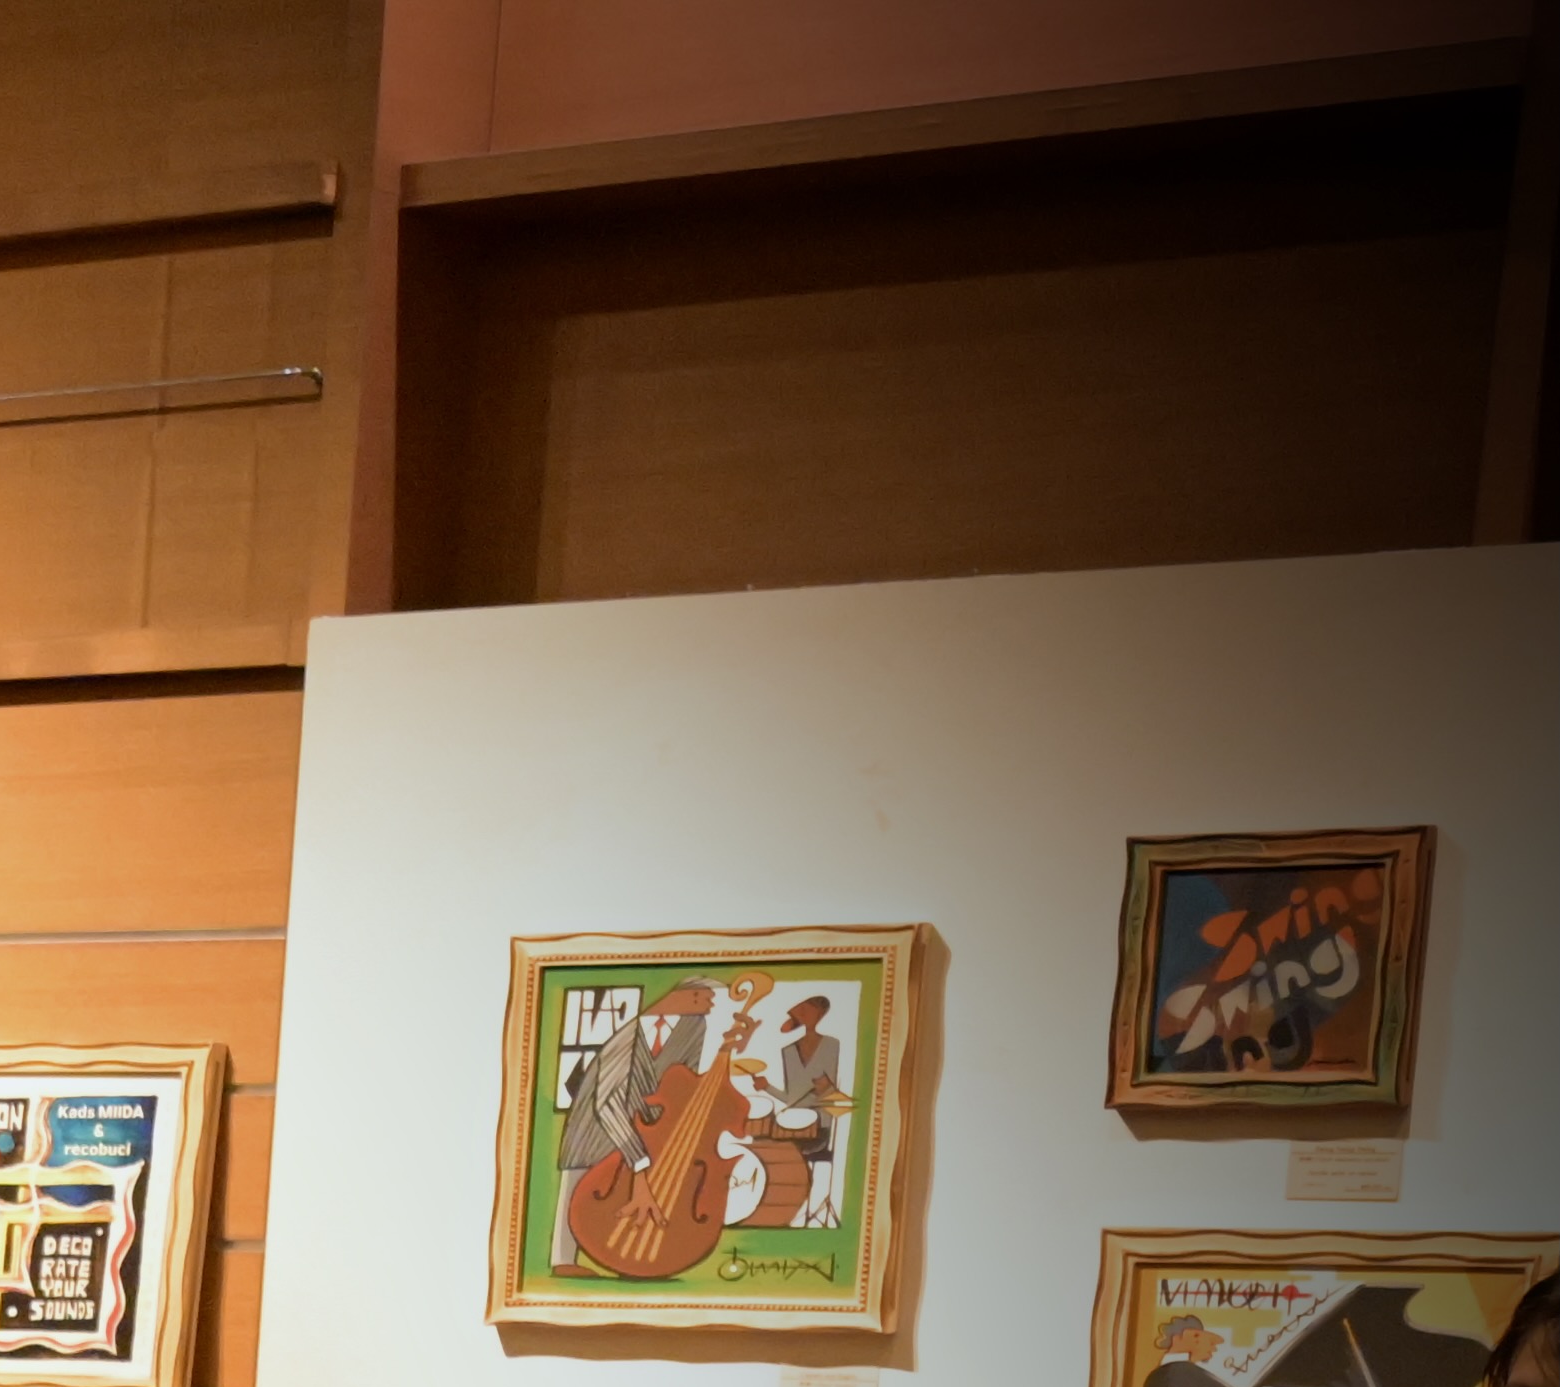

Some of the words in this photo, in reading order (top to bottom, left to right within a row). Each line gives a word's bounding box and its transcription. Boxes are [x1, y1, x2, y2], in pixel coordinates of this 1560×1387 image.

[57, 1104, 95, 1119] Kads
[98, 1104, 144, 1119] MIIDA
[93, 1124, 105, 1138] &
[40, 1280, 88, 1298] YOUR
[29, 1300, 95, 1321] SOUNDS
